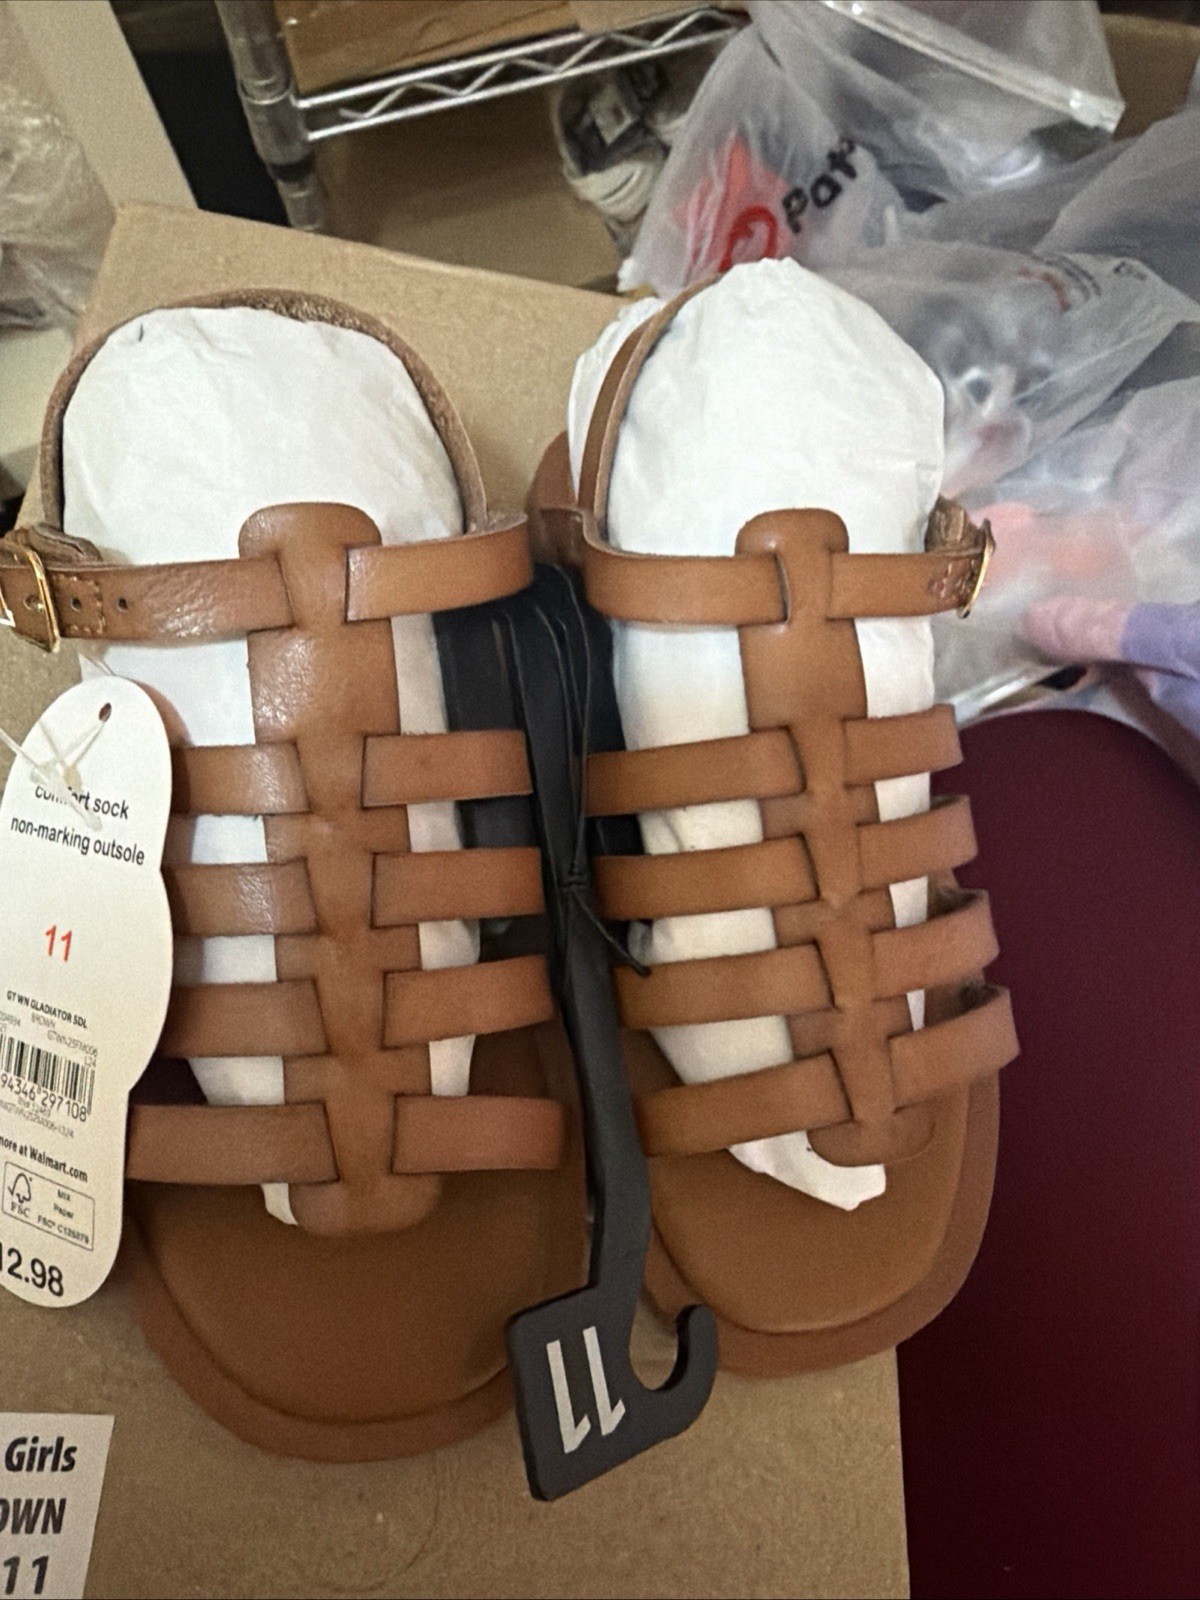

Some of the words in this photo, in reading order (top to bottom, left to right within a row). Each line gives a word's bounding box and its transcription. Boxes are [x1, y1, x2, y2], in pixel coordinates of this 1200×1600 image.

[93, 798, 130, 820] sock
[11, 816, 91, 856] non-marking
[93, 838, 145, 866] outsole
[45, 924, 73, 963] 11
[6, 990, 17, 1001] GT
[30, 998, 72, 1023] GLADIATOR
[18, 1144, 28, 1157] at
[29, 1145, 88, 1183] Walmart.com
[10, 1201, 31, 1218] FSC
[546, 1325, 626, 1454] 11
[4, 1436, 78, 1473] Girls
